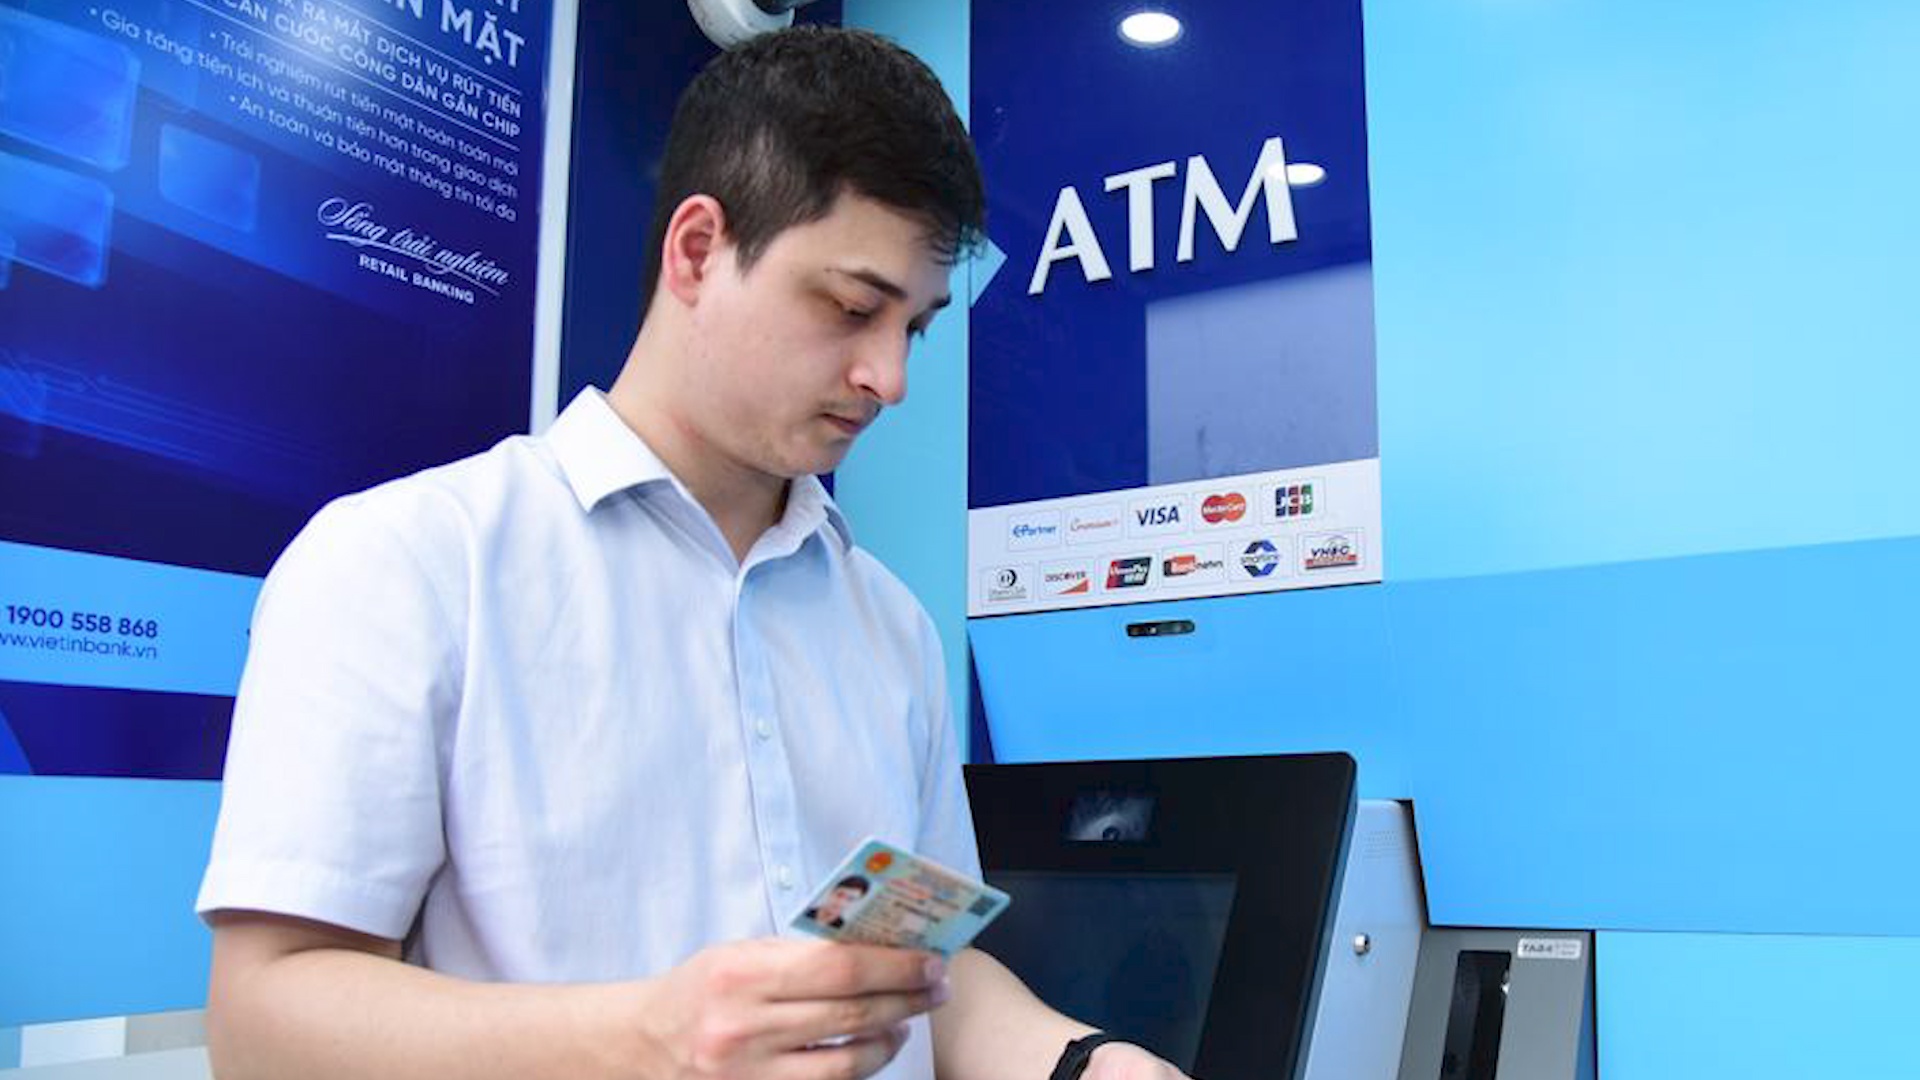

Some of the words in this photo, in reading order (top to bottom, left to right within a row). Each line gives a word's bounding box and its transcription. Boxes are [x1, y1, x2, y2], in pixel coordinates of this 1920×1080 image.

[302, 1, 328, 24] RA
[377, 36, 422, 70] DỊCH
[426, 59, 449, 86] VỤ
[452, 72, 484, 98] RÚT
[441, 0, 525, 68] MẶT
[101, 9, 140, 39] Gia
[411, 143, 451, 174] trong
[453, 162, 486, 187] giao
[339, 43, 397, 81] CÔNG
[482, 111, 521, 137] CHIP
[239, 95, 265, 119] An
[454, 185, 475, 205] tin
[1028, 136, 1299, 296] ATM
[359, 253, 409, 283] RETAIL
[412, 272, 476, 306] BANKING
[1136, 505, 1181, 527] VISA
[1275, 484, 1314, 517] JCB
[1045, 571, 1088, 583] DISCOVER
[6, 605, 64, 629] 1900
[71, 611, 112, 634] 558
[118, 617, 158, 639] 868
